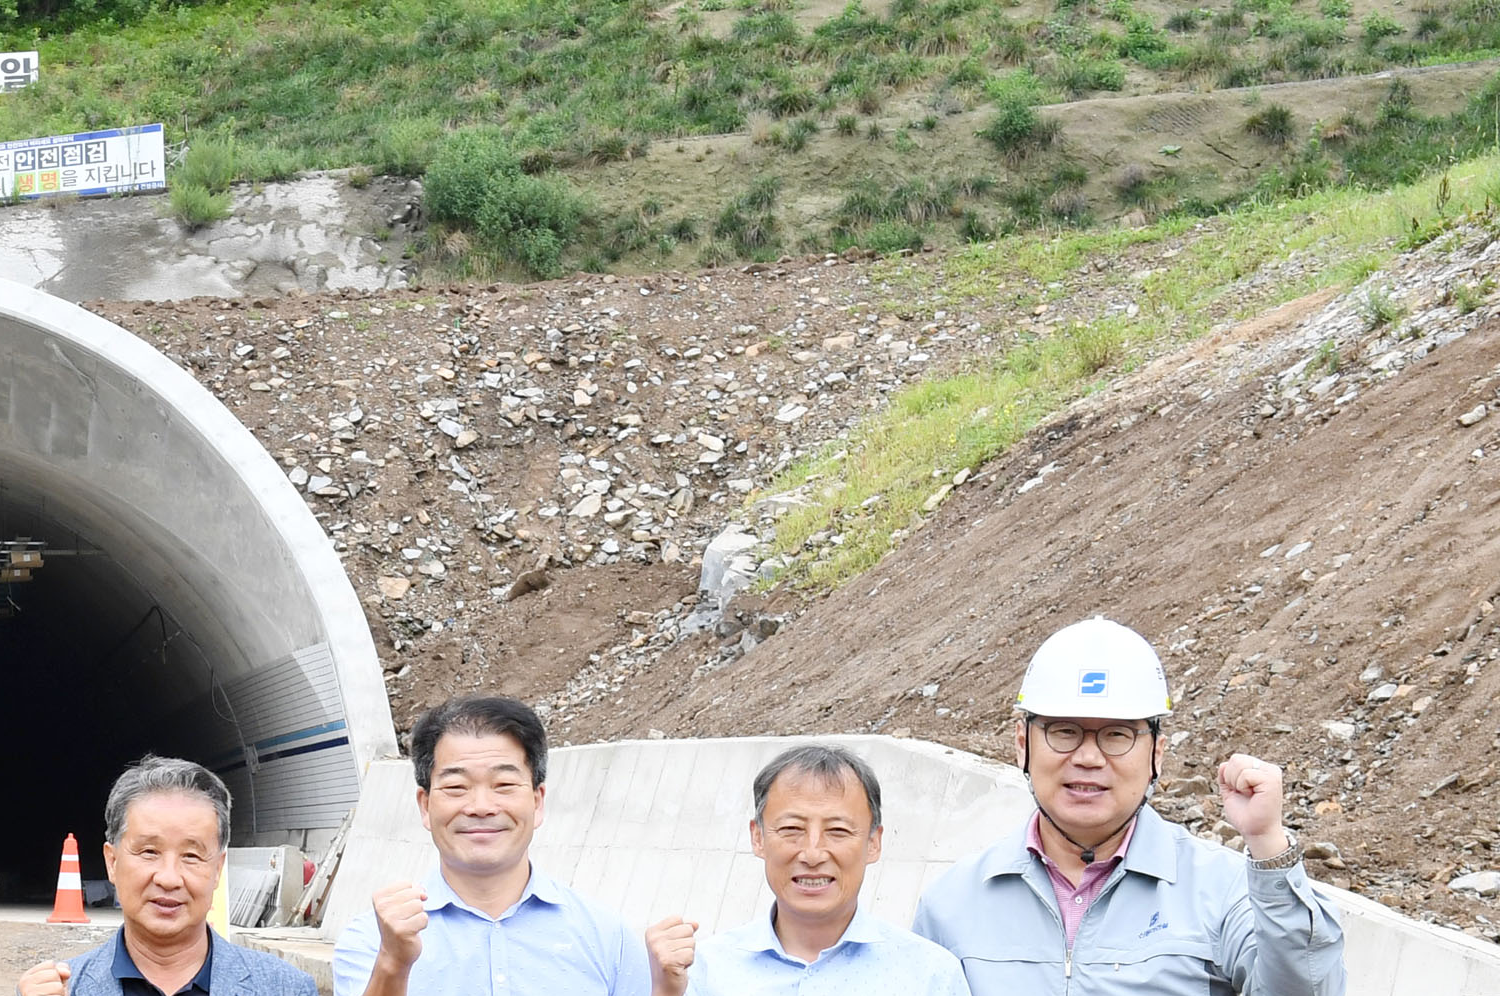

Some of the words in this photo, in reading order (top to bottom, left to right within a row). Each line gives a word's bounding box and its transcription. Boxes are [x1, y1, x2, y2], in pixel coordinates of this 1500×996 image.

[14, 141, 107, 172] 안전점검
[15, 168, 79, 193] 생명을
[85, 160, 156, 184] 지킵니다
